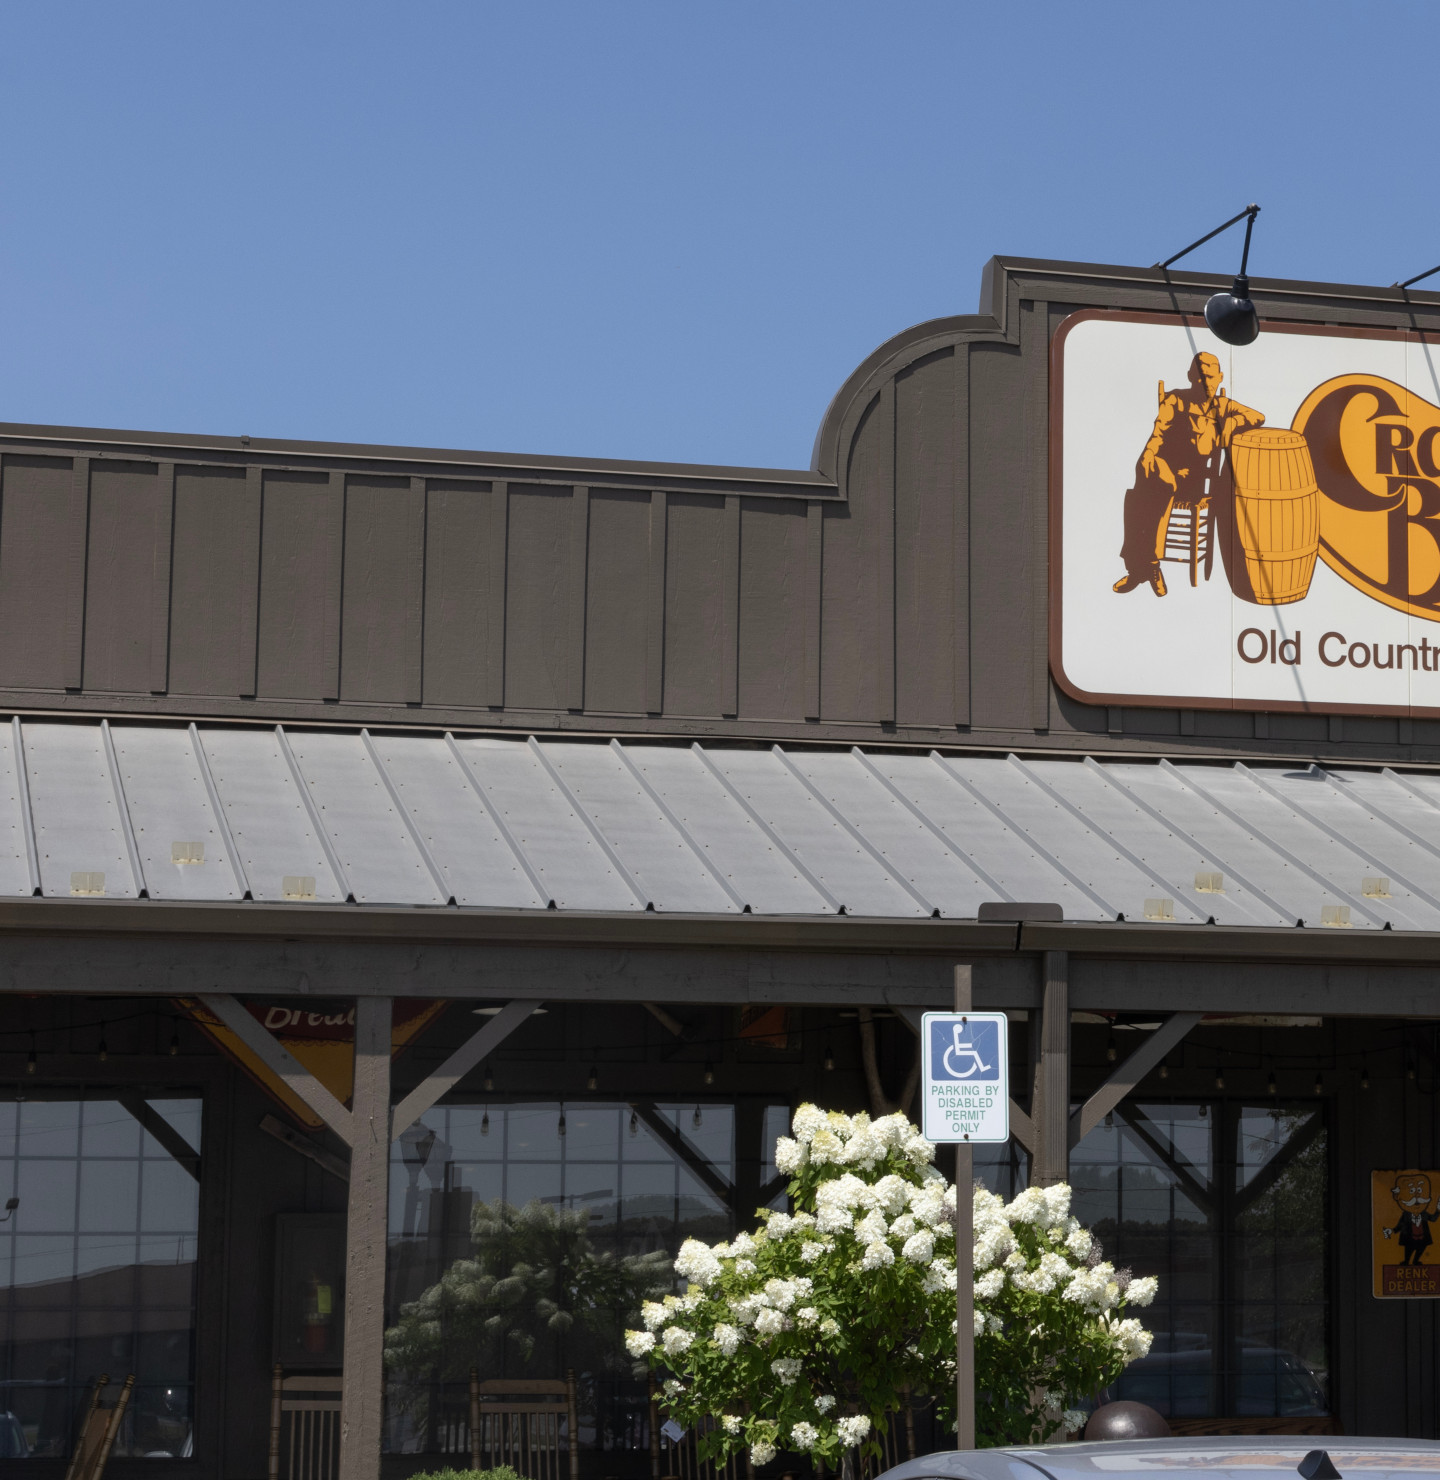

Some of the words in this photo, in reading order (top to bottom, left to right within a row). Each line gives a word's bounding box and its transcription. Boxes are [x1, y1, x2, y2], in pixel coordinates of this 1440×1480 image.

[1237, 627, 1301, 666] Old
[931, 1085, 980, 1096] PARKING
[985, 1085, 1000, 1096] BY
[938, 1097, 993, 1108] DISABLED
[945, 1110, 986, 1120] PERMIT
[952, 1122, 980, 1133] ONLY
[1396, 1267, 1429, 1279] RENK
[1388, 1280, 1437, 1292] DEALER
